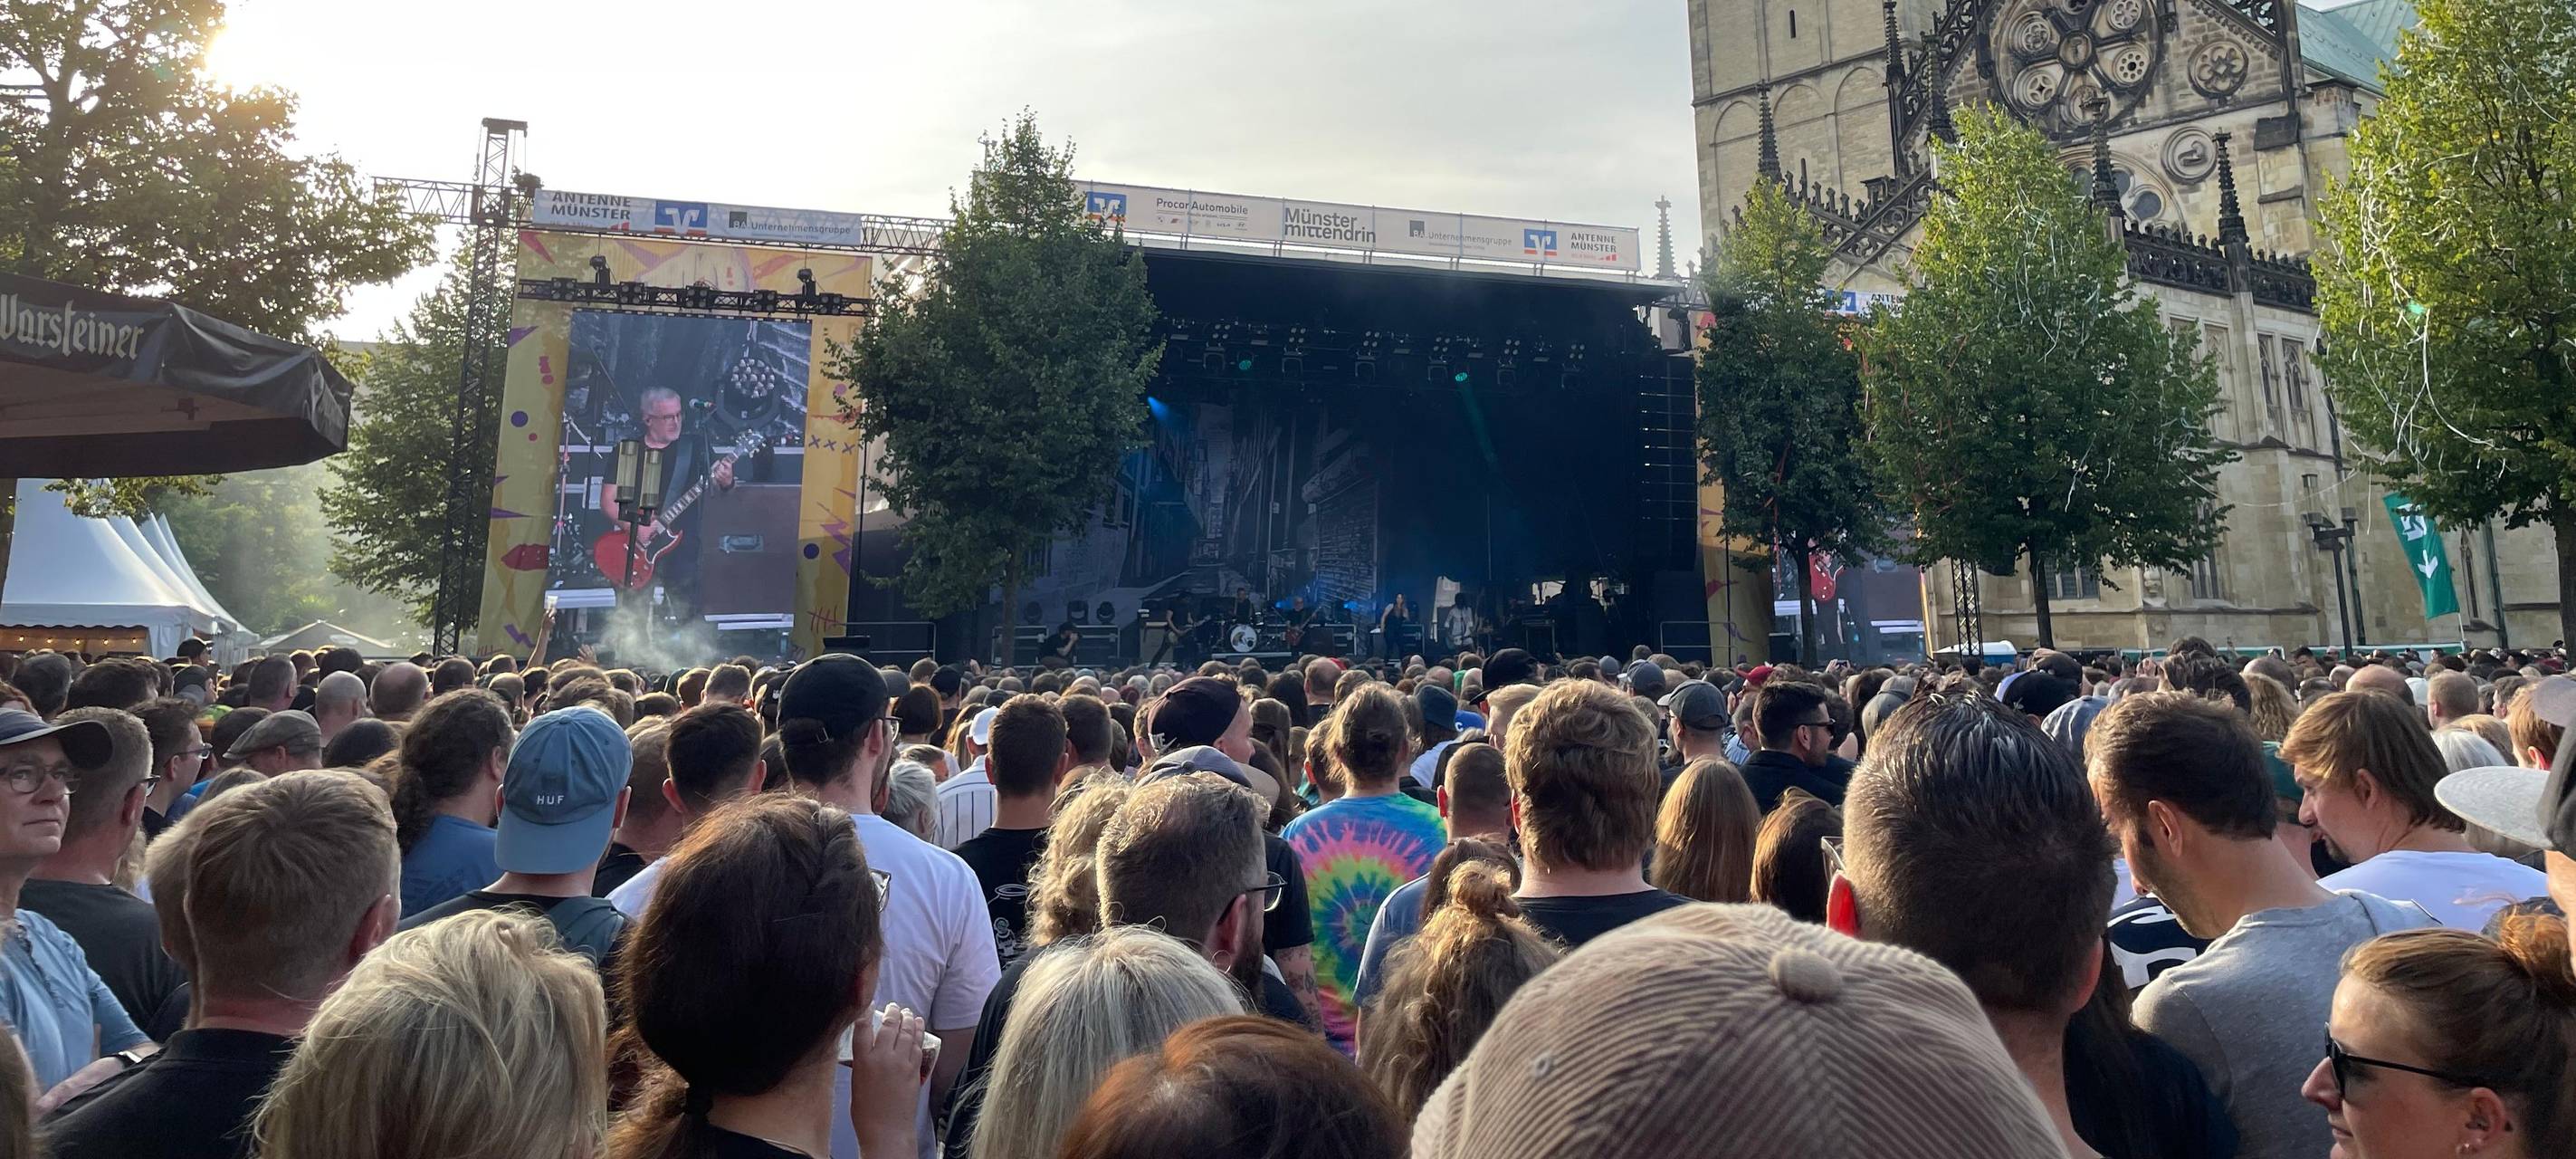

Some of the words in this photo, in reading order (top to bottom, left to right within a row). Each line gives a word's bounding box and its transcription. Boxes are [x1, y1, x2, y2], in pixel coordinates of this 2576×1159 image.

[552, 192, 631, 207] ANTENNE
[551, 204, 631, 220] MÜNSTER
[1191, 201, 1248, 216] Automobile
[1285, 207, 1358, 227] Münster
[751, 222, 851, 235] Unternehmensgruppe
[1284, 225, 1377, 243] mittendrin
[1571, 233, 1616, 244] ANTENNE
[1570, 241, 1617, 253] MÜNSTER
[537, 795, 565, 805] HUF
